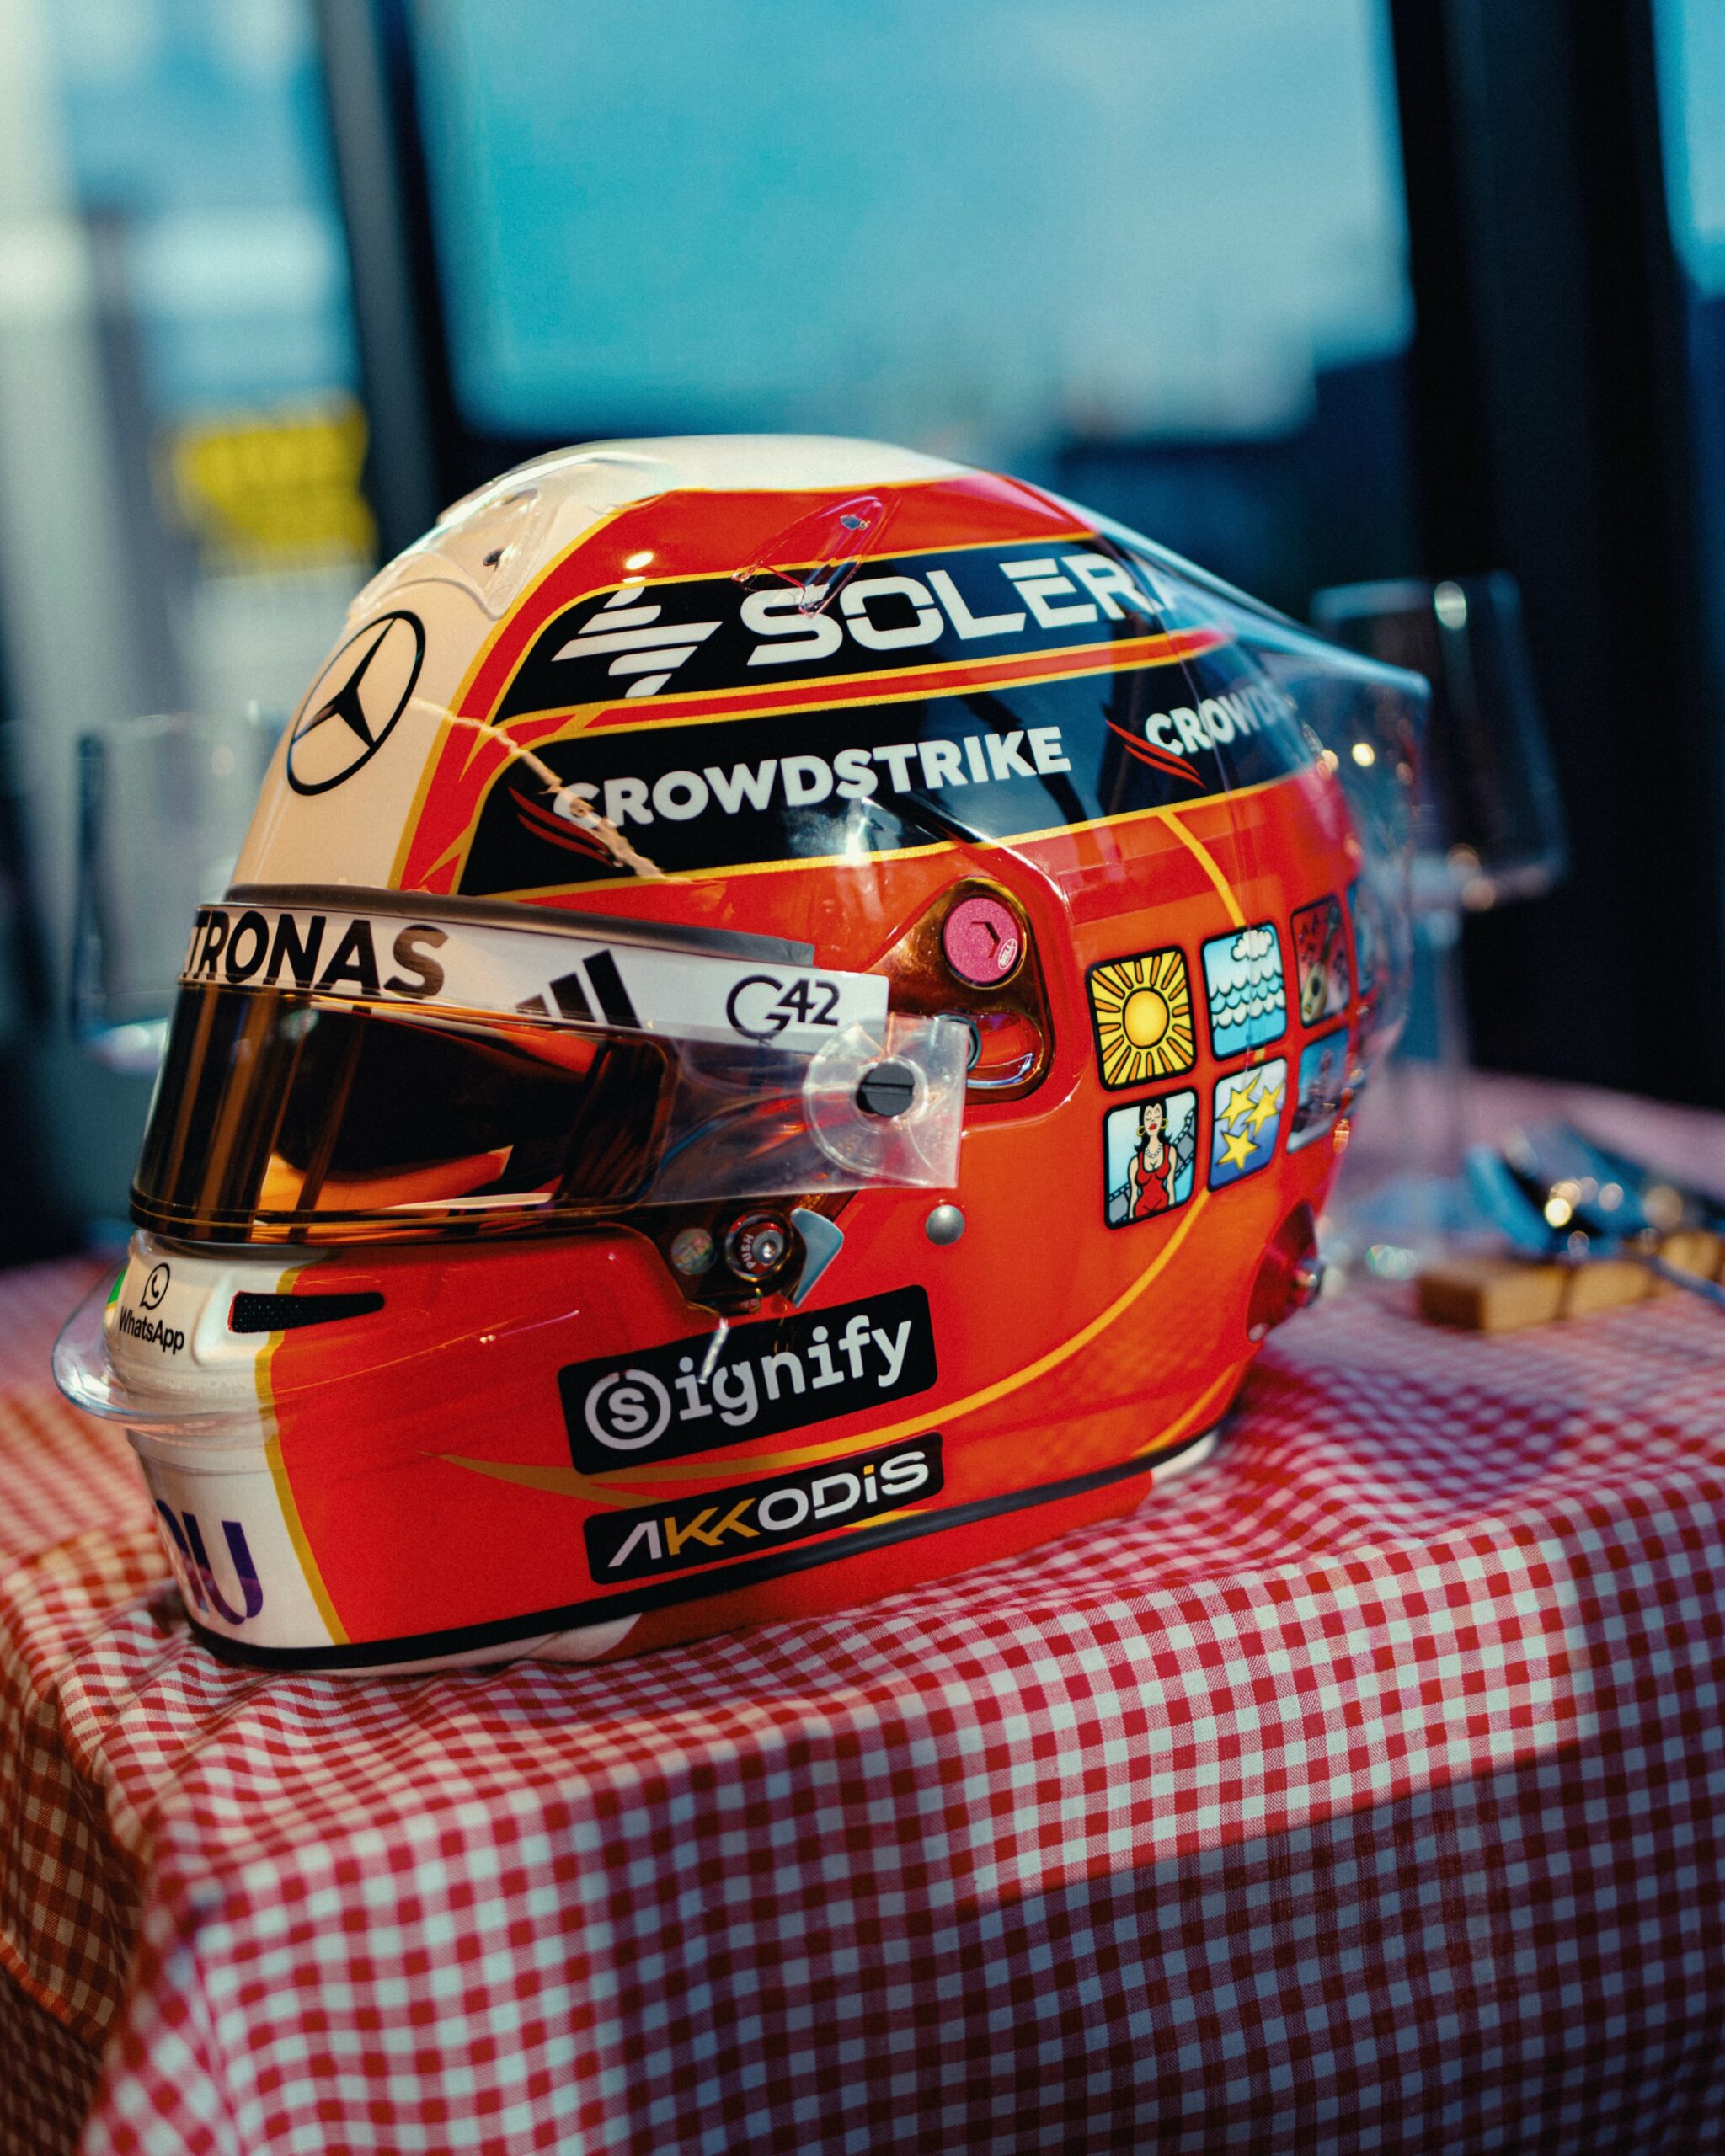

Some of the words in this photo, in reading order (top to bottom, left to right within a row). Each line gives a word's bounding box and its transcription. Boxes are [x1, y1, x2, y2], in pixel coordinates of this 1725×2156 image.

[553, 725, 1072, 829] CROWDSTRIKE
[726, 974, 840, 1040] G42
[740, 1234, 756, 1270] PUSH
[119, 1306, 185, 1355] WhatsApp
